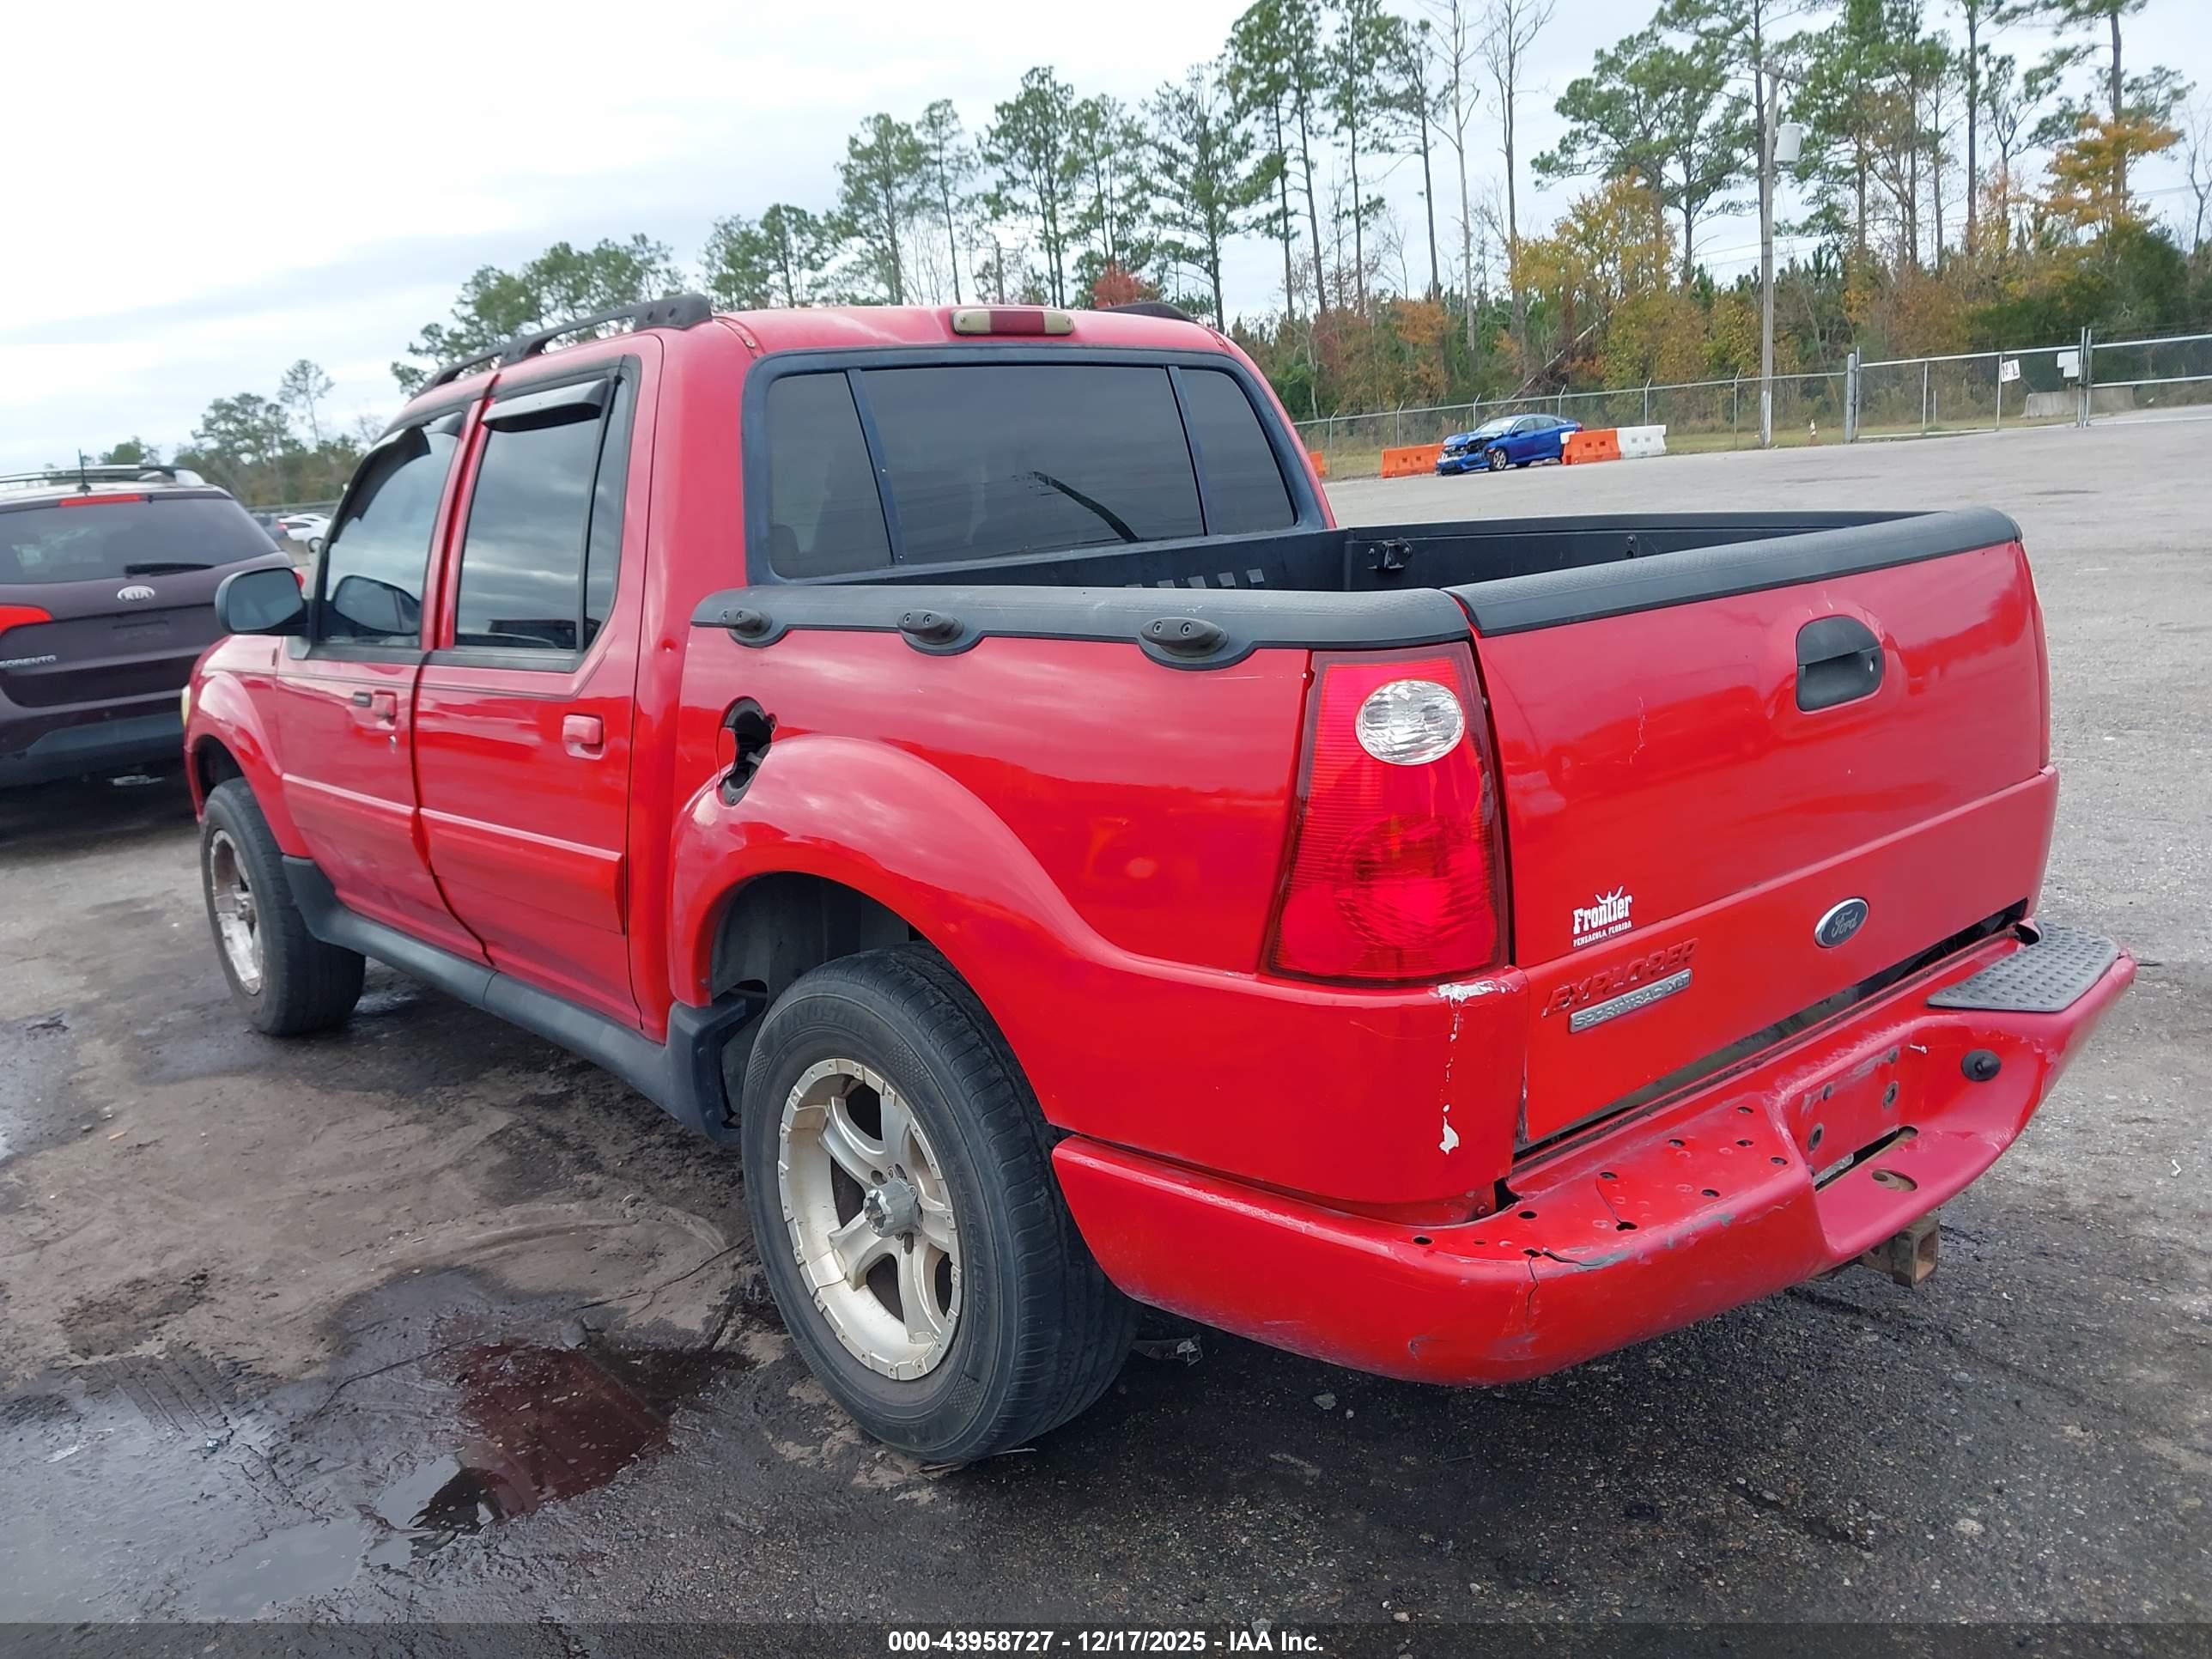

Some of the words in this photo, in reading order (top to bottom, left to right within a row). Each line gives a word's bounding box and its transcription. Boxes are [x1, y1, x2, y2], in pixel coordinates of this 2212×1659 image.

[1572, 892, 1632, 935] Frontier
[1608, 920, 1632, 936] FLORIDA
[1830, 908, 1859, 939] Ford
[1541, 937, 1698, 1018] EXPLORER
[1573, 1000, 1623, 1028] SPORT
